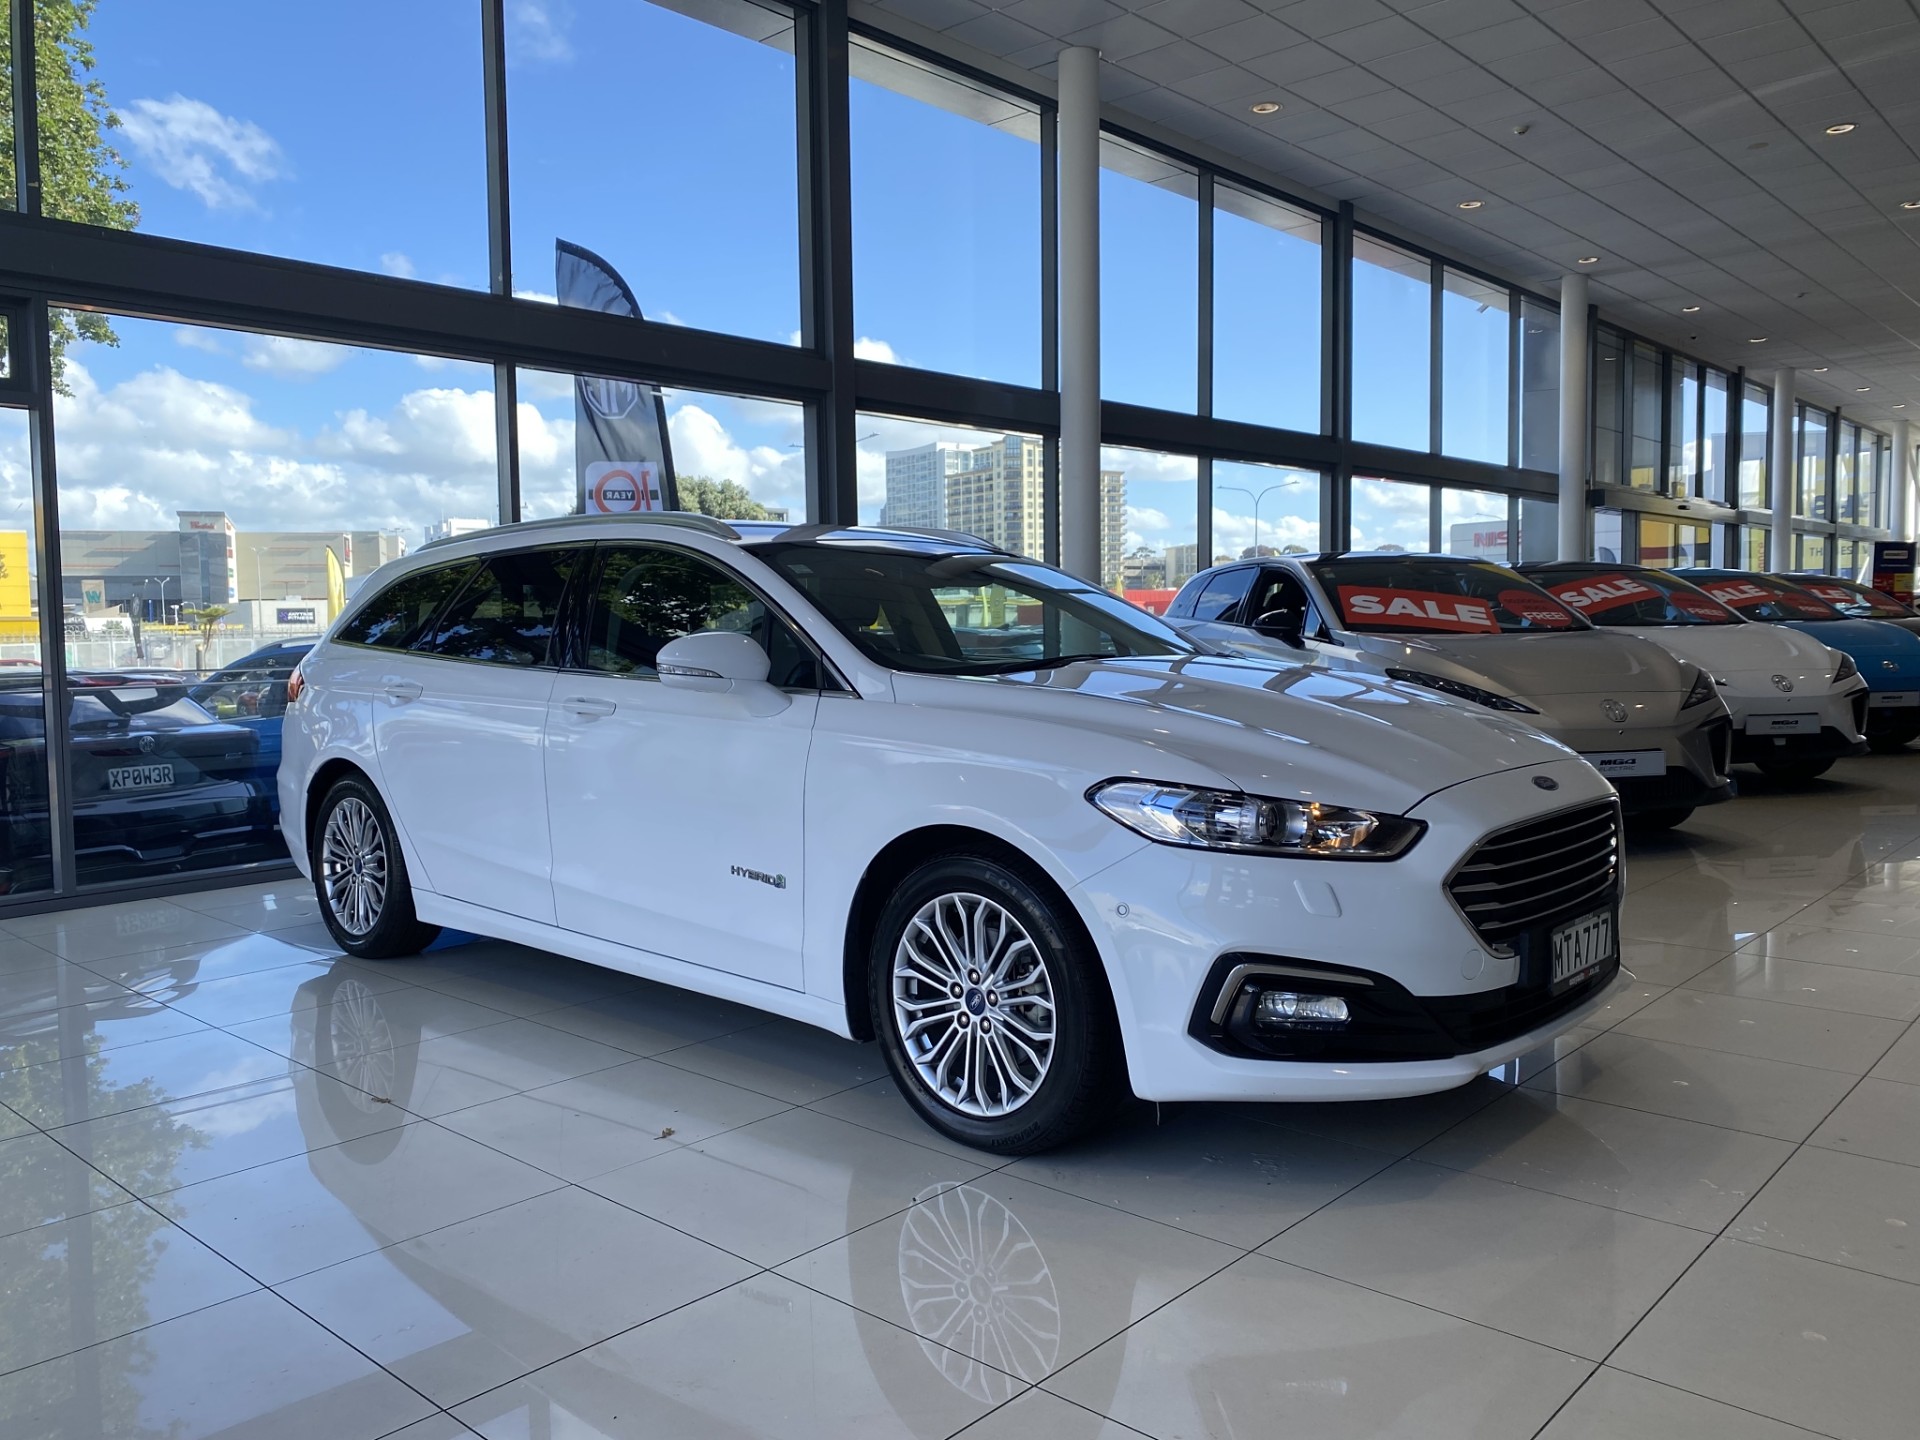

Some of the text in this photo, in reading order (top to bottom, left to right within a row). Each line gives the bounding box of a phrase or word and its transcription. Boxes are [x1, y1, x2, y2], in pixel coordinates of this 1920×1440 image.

[1473, 530, 1521, 547] NIS
[1560, 579, 1649, 607] SALE
[1710, 585, 1769, 603] ALE
[1811, 588, 1851, 600] LE
[1349, 594, 1492, 626] SALE
[1522, 611, 1569, 620] FREE!
[1599, 758, 1637, 766] MG4
[731, 865, 776, 886] HYBRID
[1554, 917, 1609, 979] MTA777
